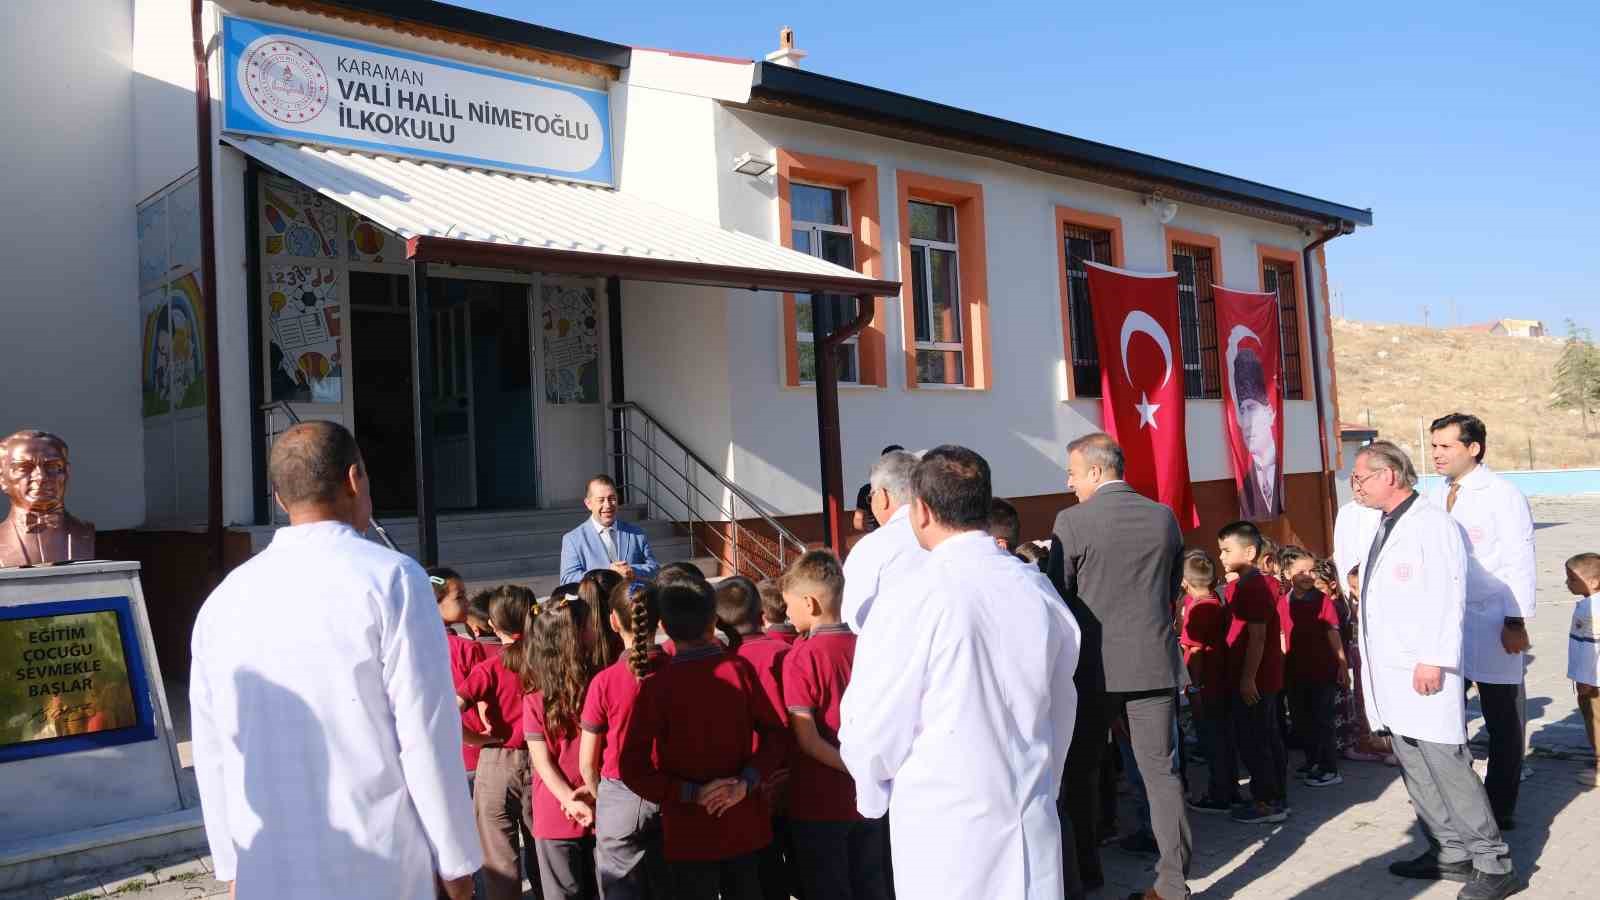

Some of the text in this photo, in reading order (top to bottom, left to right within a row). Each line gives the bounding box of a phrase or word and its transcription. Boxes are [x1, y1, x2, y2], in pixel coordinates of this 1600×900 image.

[337, 55, 424, 87] KARAMAN
[337, 78, 391, 108] VALİ
[398, 88, 463, 120] HALİL
[468, 101, 589, 141] NİMETOĞLU
[338, 101, 455, 144] İLKOKULU
[29, 626, 86, 644] EĞİTİM
[23, 643, 93, 665] ÇOCUĞU
[16, 660, 101, 681] SEVMEKLE
[29, 678, 93, 697] BAŞLAR
